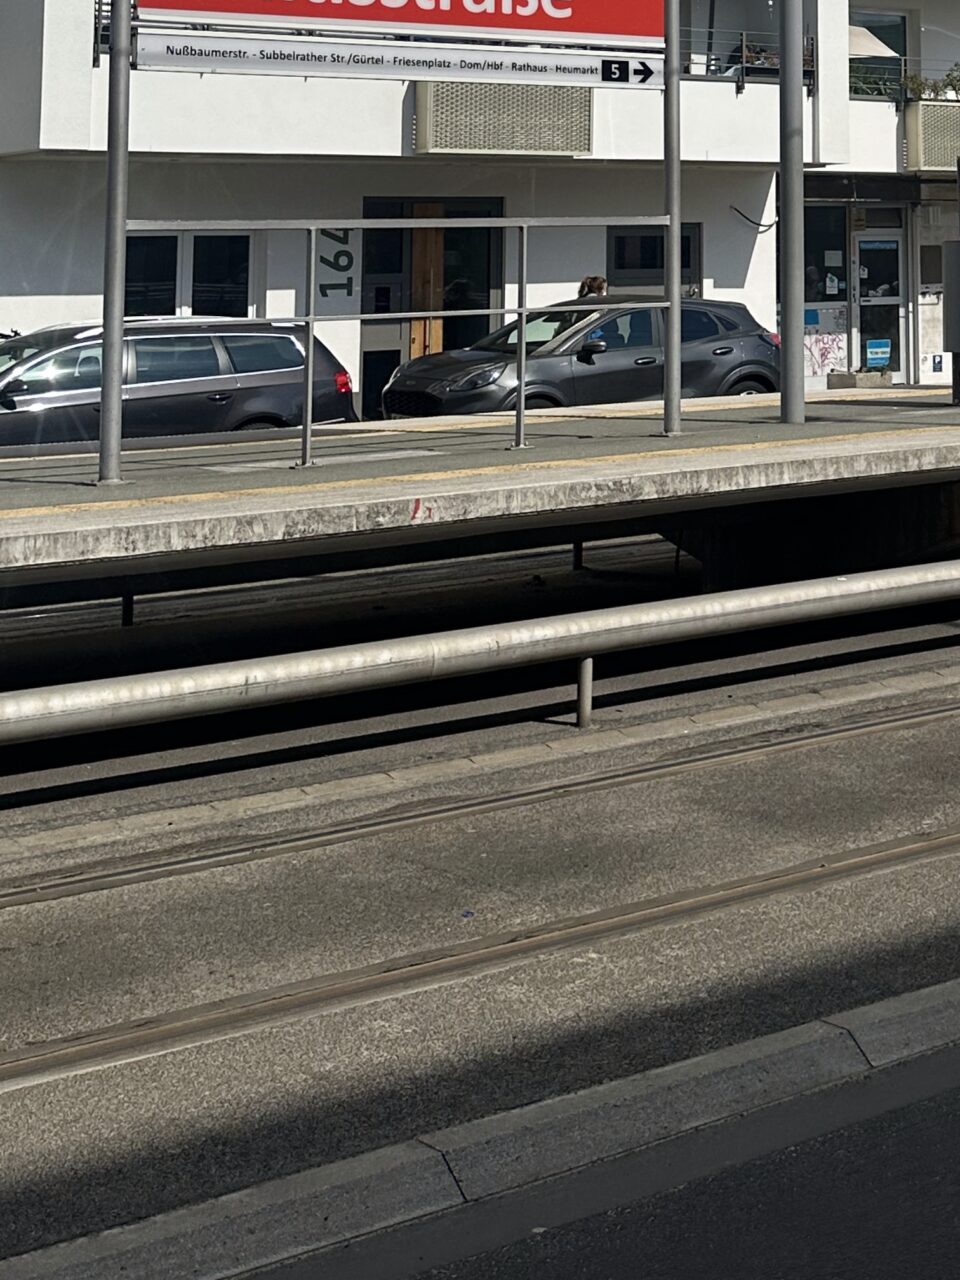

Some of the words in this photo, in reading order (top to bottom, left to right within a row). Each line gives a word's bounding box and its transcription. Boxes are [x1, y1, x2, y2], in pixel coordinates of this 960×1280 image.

[165, 45, 249, 60] Nußbaumerstr.
[259, 50, 327, 64] Subbelrather
[393, 56, 452, 70] Friesenplatz
[460, 60, 504, 72] Dom/Hbf
[511, 61, 548, 73] Rathaus
[555, 64, 599, 76] Heumarkt
[611, 63, 620, 78] 5
[319, 229, 354, 298] 164
